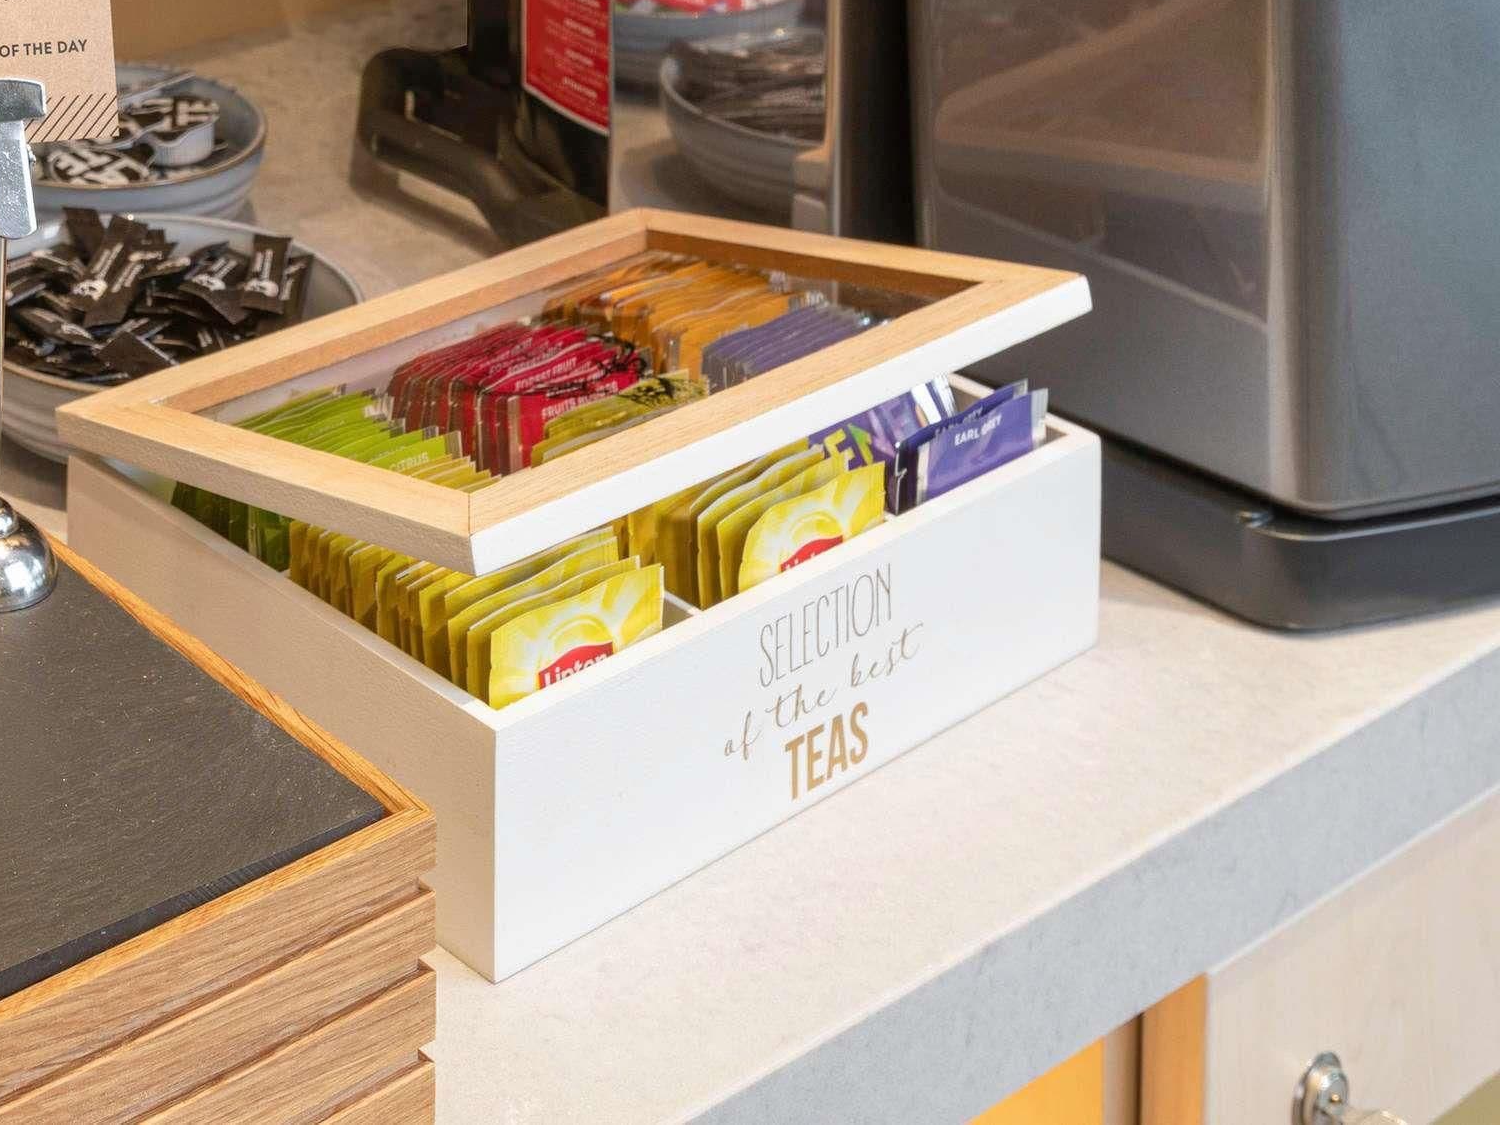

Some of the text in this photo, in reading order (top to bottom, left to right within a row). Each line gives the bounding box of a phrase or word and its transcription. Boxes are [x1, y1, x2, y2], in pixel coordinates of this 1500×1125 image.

[23, 40, 54, 56] THE
[56, 38, 89, 54] DAY
[954, 427, 980, 446] EARL
[759, 563, 892, 687] SELECTION
[724, 623, 924, 760] of the best
[785, 702, 869, 801] TEAS
